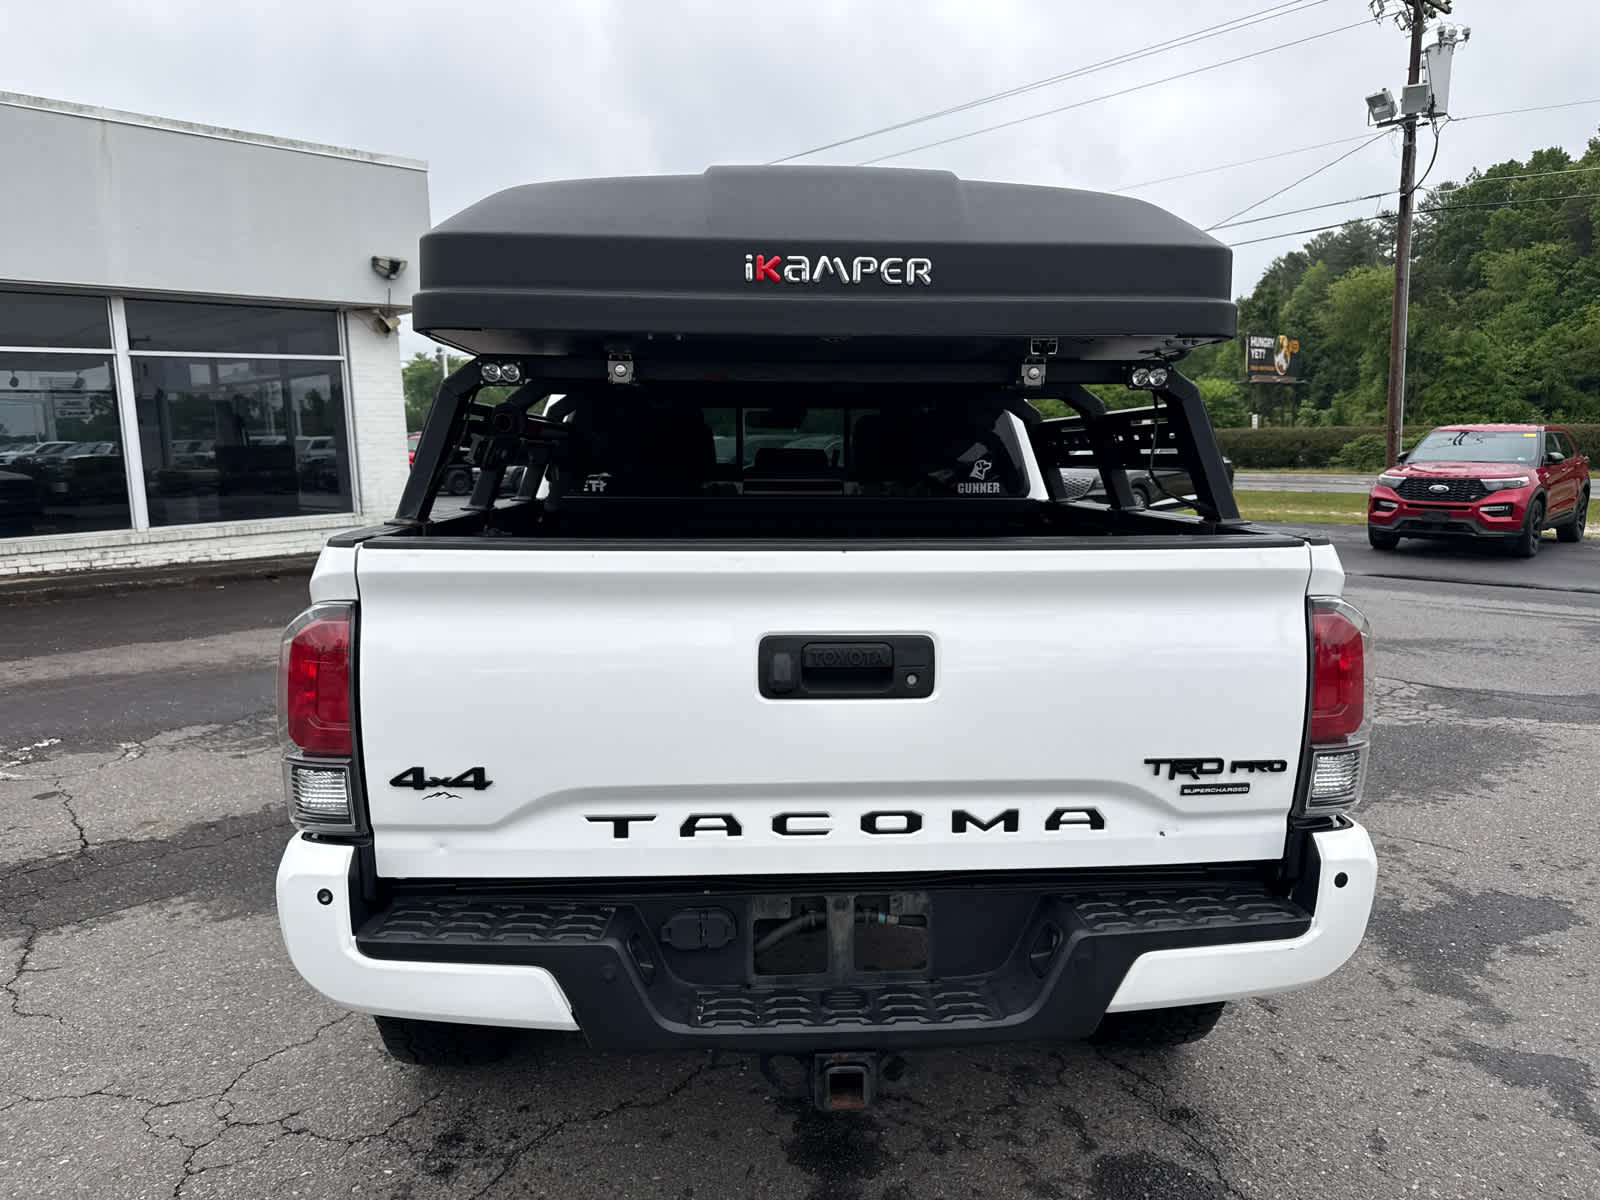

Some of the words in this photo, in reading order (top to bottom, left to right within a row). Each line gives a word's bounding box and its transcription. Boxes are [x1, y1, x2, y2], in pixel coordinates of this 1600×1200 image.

[1250, 348, 1266, 359] YETI
[957, 482, 1000, 494] GUNNER
[806, 650, 889, 666] TOYOTA
[1144, 758, 1224, 780] TRD
[1230, 760, 1287, 773] PRO
[584, 806, 1106, 839] TACOMA
